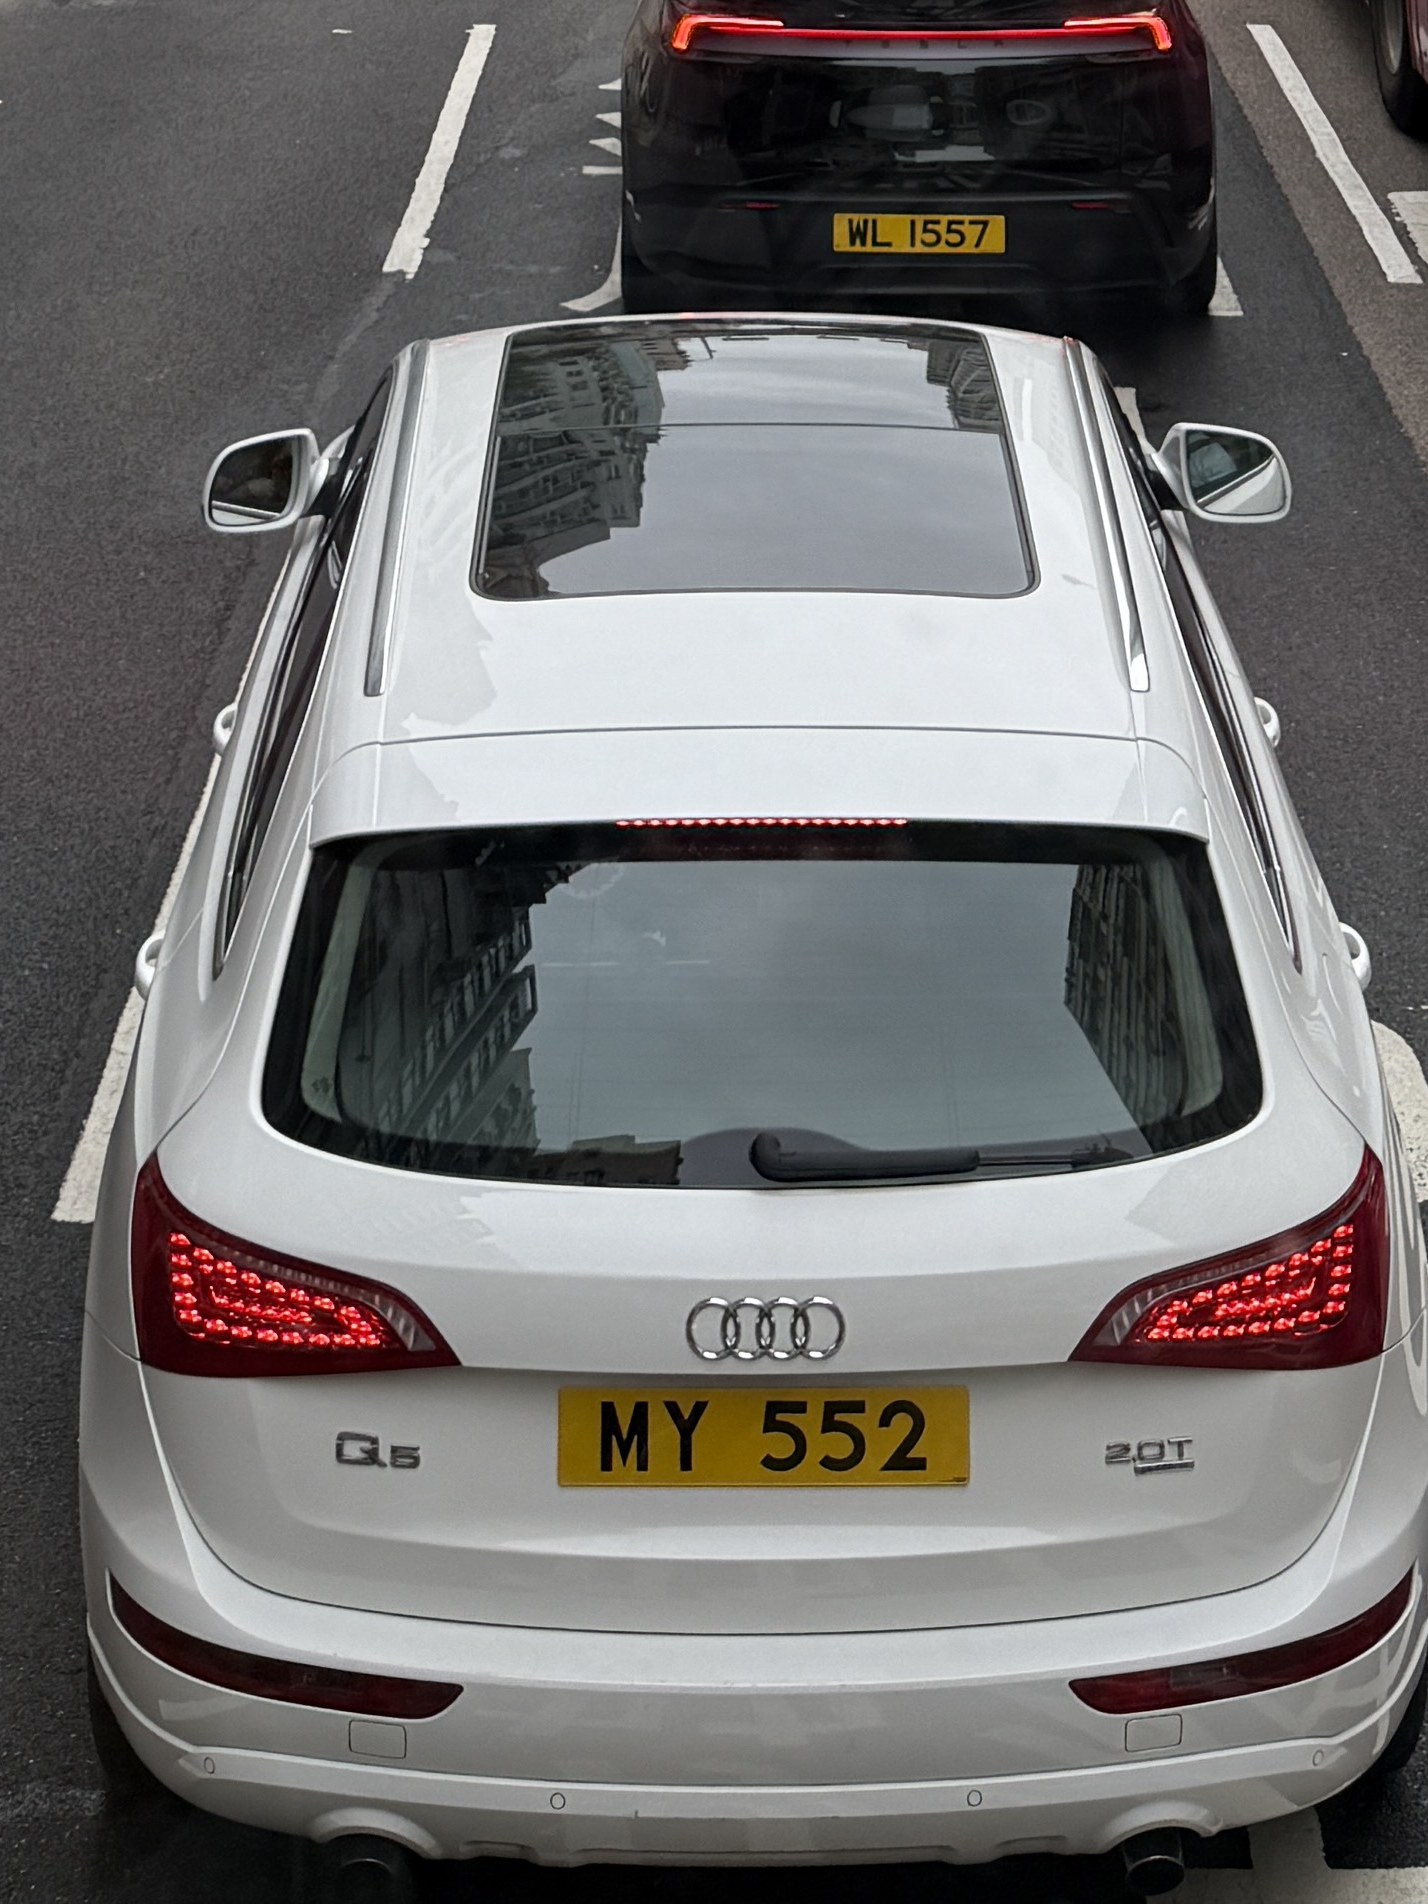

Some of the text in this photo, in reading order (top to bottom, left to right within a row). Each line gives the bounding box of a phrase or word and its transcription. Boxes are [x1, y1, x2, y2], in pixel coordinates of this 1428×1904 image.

[848, 218, 990, 248] WL 1557
[336, 1431, 421, 1469] Q5
[601, 1399, 927, 1472] MY 552
